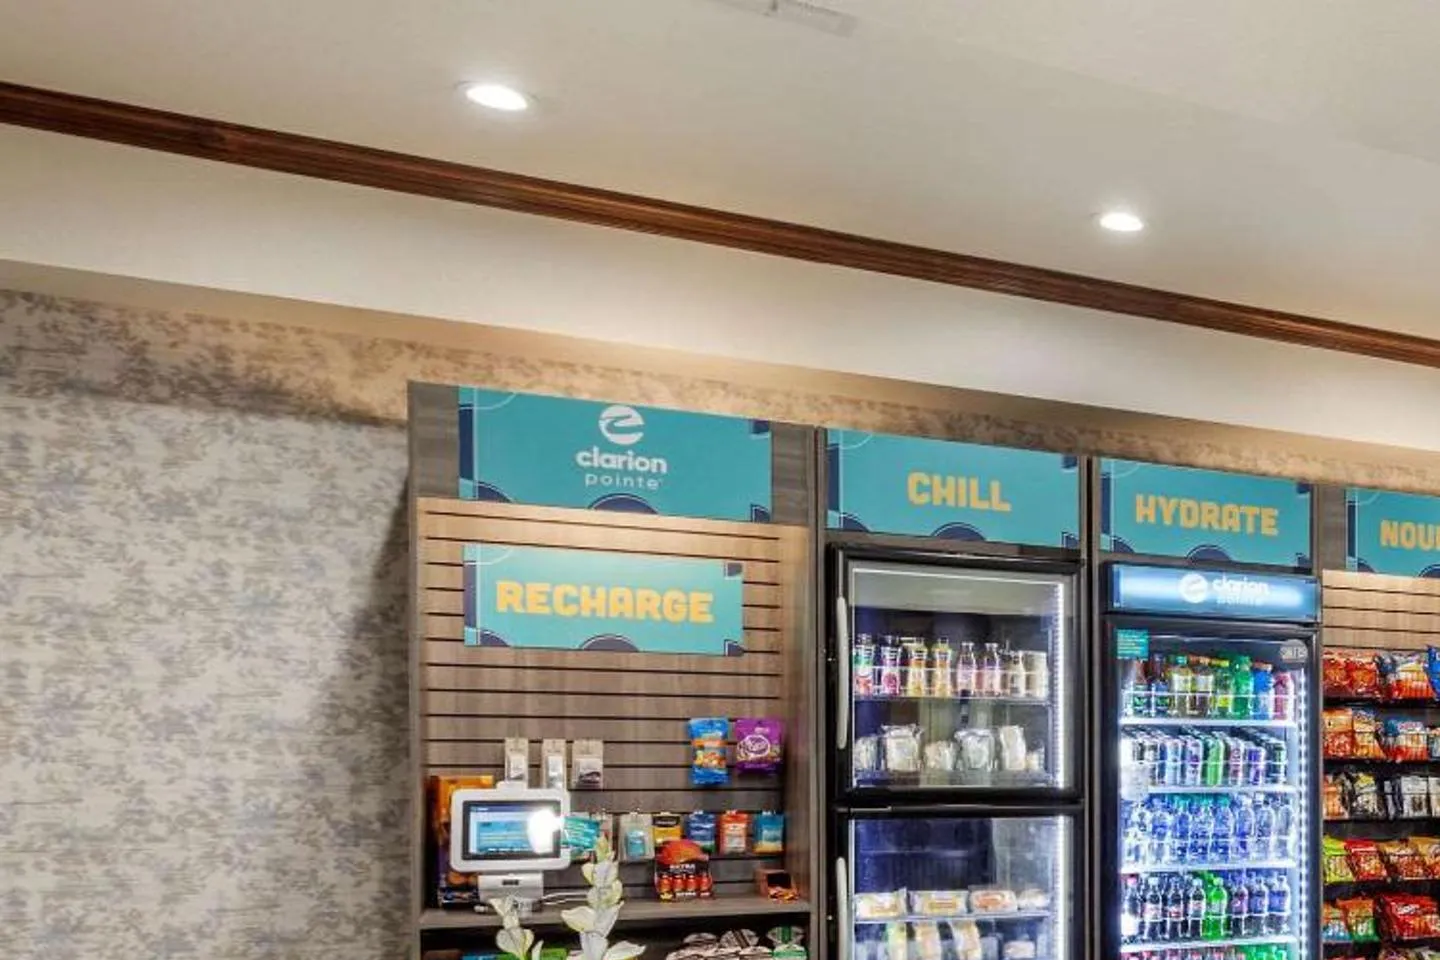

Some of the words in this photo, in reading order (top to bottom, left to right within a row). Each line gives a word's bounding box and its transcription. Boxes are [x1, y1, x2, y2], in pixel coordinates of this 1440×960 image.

[575, 446, 667, 474] clarion
[585, 473, 660, 490] pointe
[907, 472, 1011, 512] CHILL
[1135, 494, 1279, 536] HYDRATE
[495, 580, 715, 624] RECHARGE
